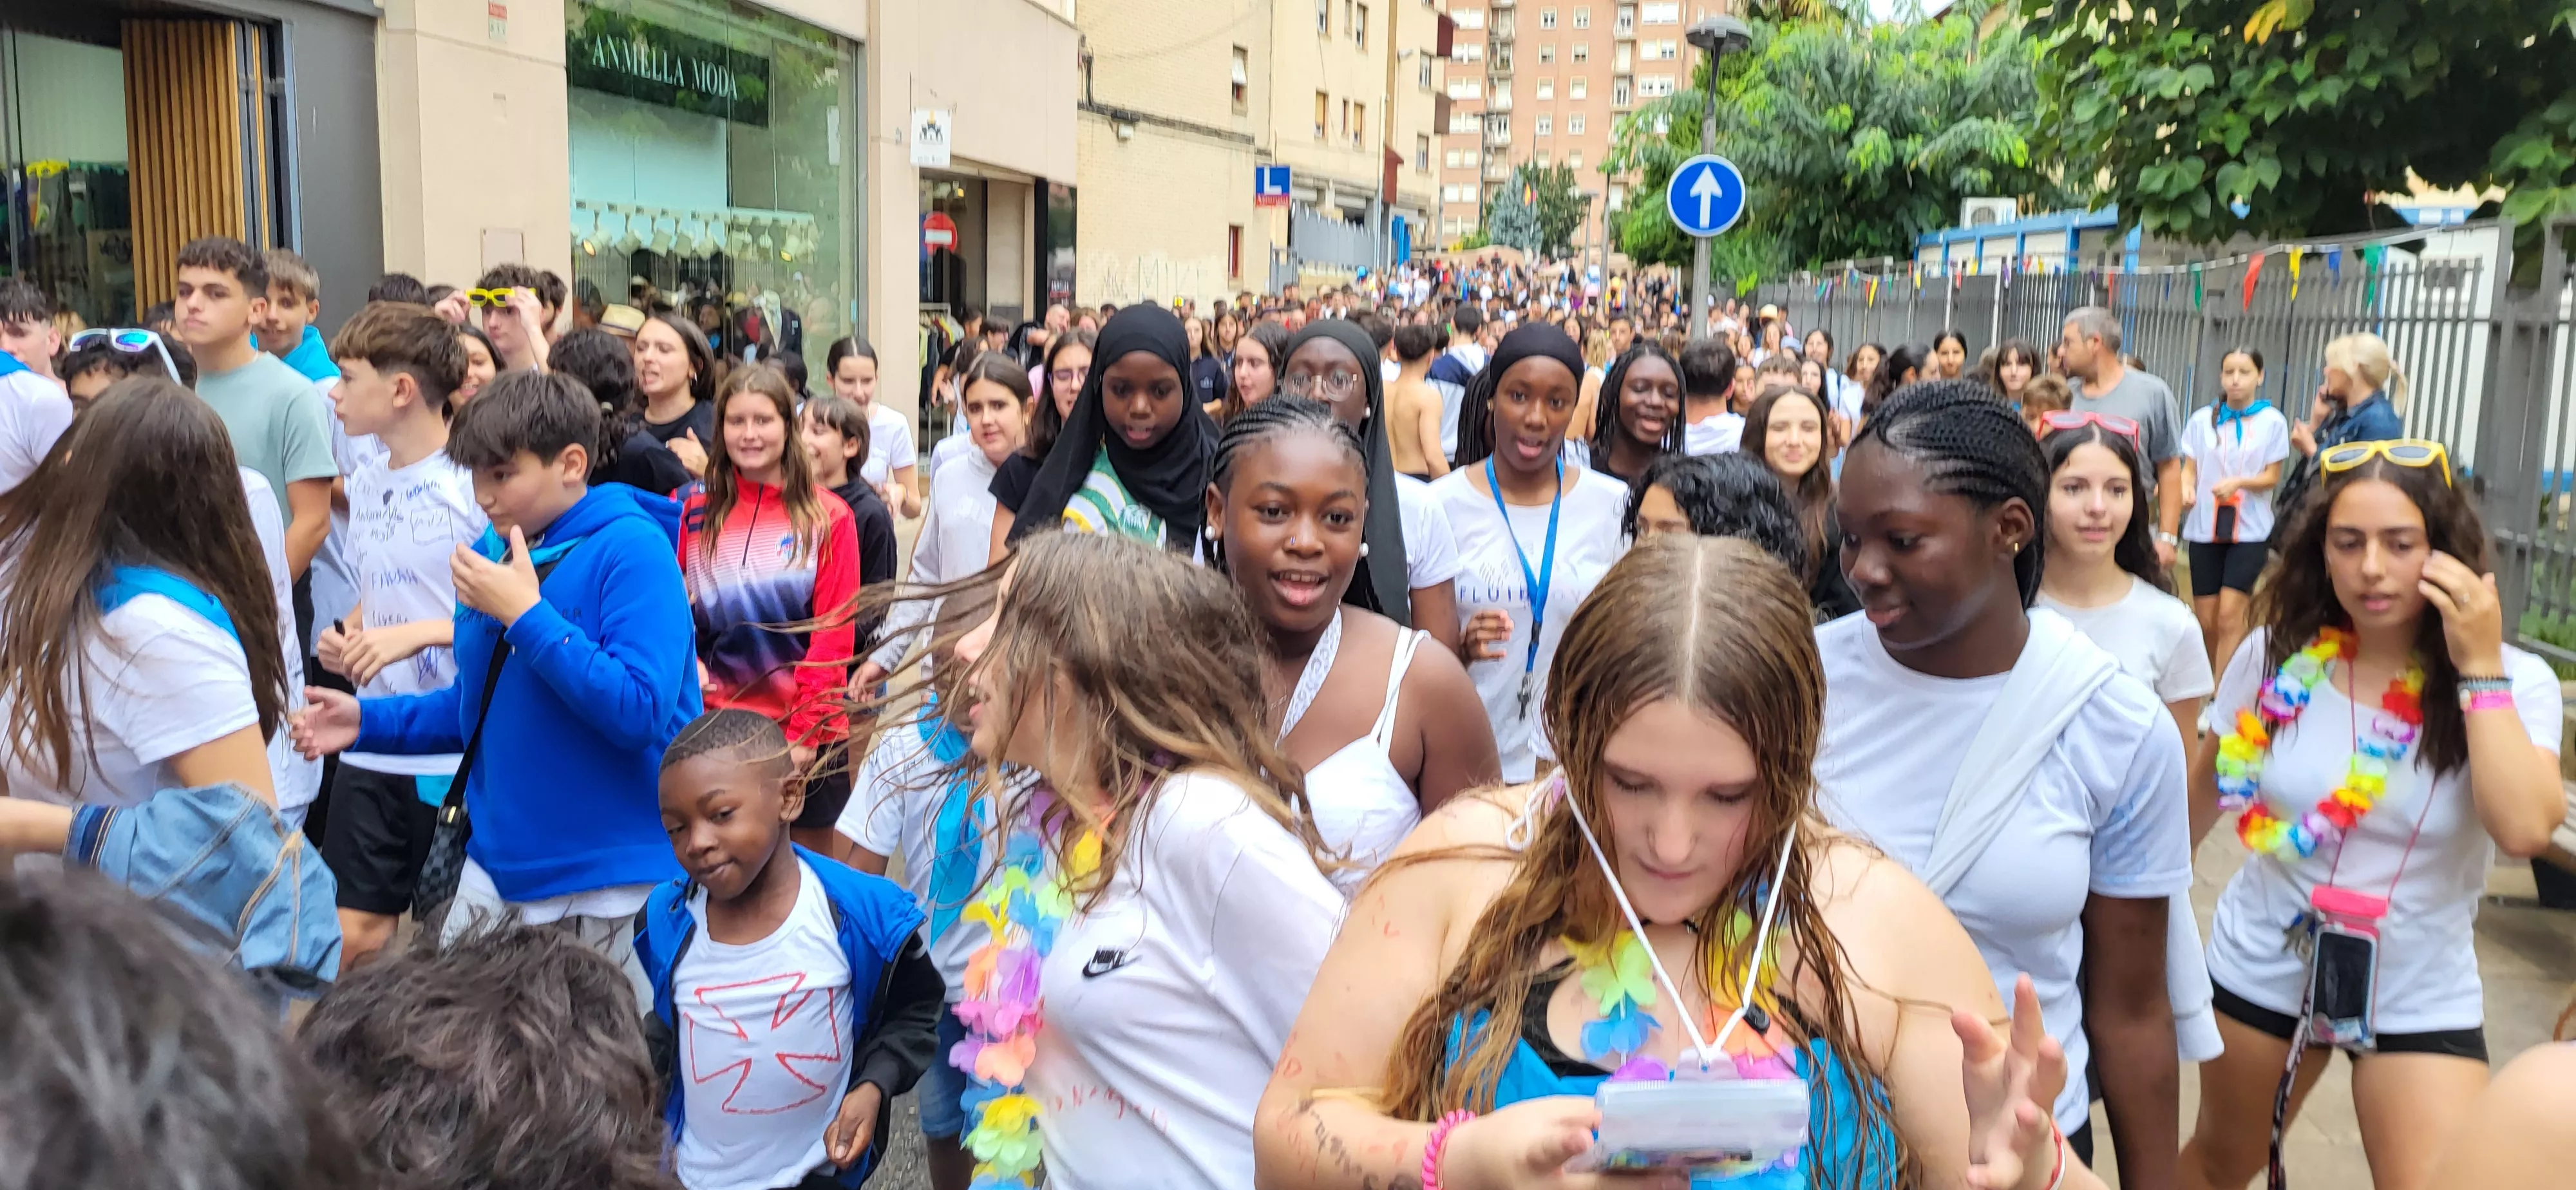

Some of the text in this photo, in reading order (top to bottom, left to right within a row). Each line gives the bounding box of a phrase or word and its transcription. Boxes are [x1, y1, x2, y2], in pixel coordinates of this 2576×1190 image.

[592, 32, 738, 102] ANMELLA MODA
[1264, 165, 1282, 195] L
